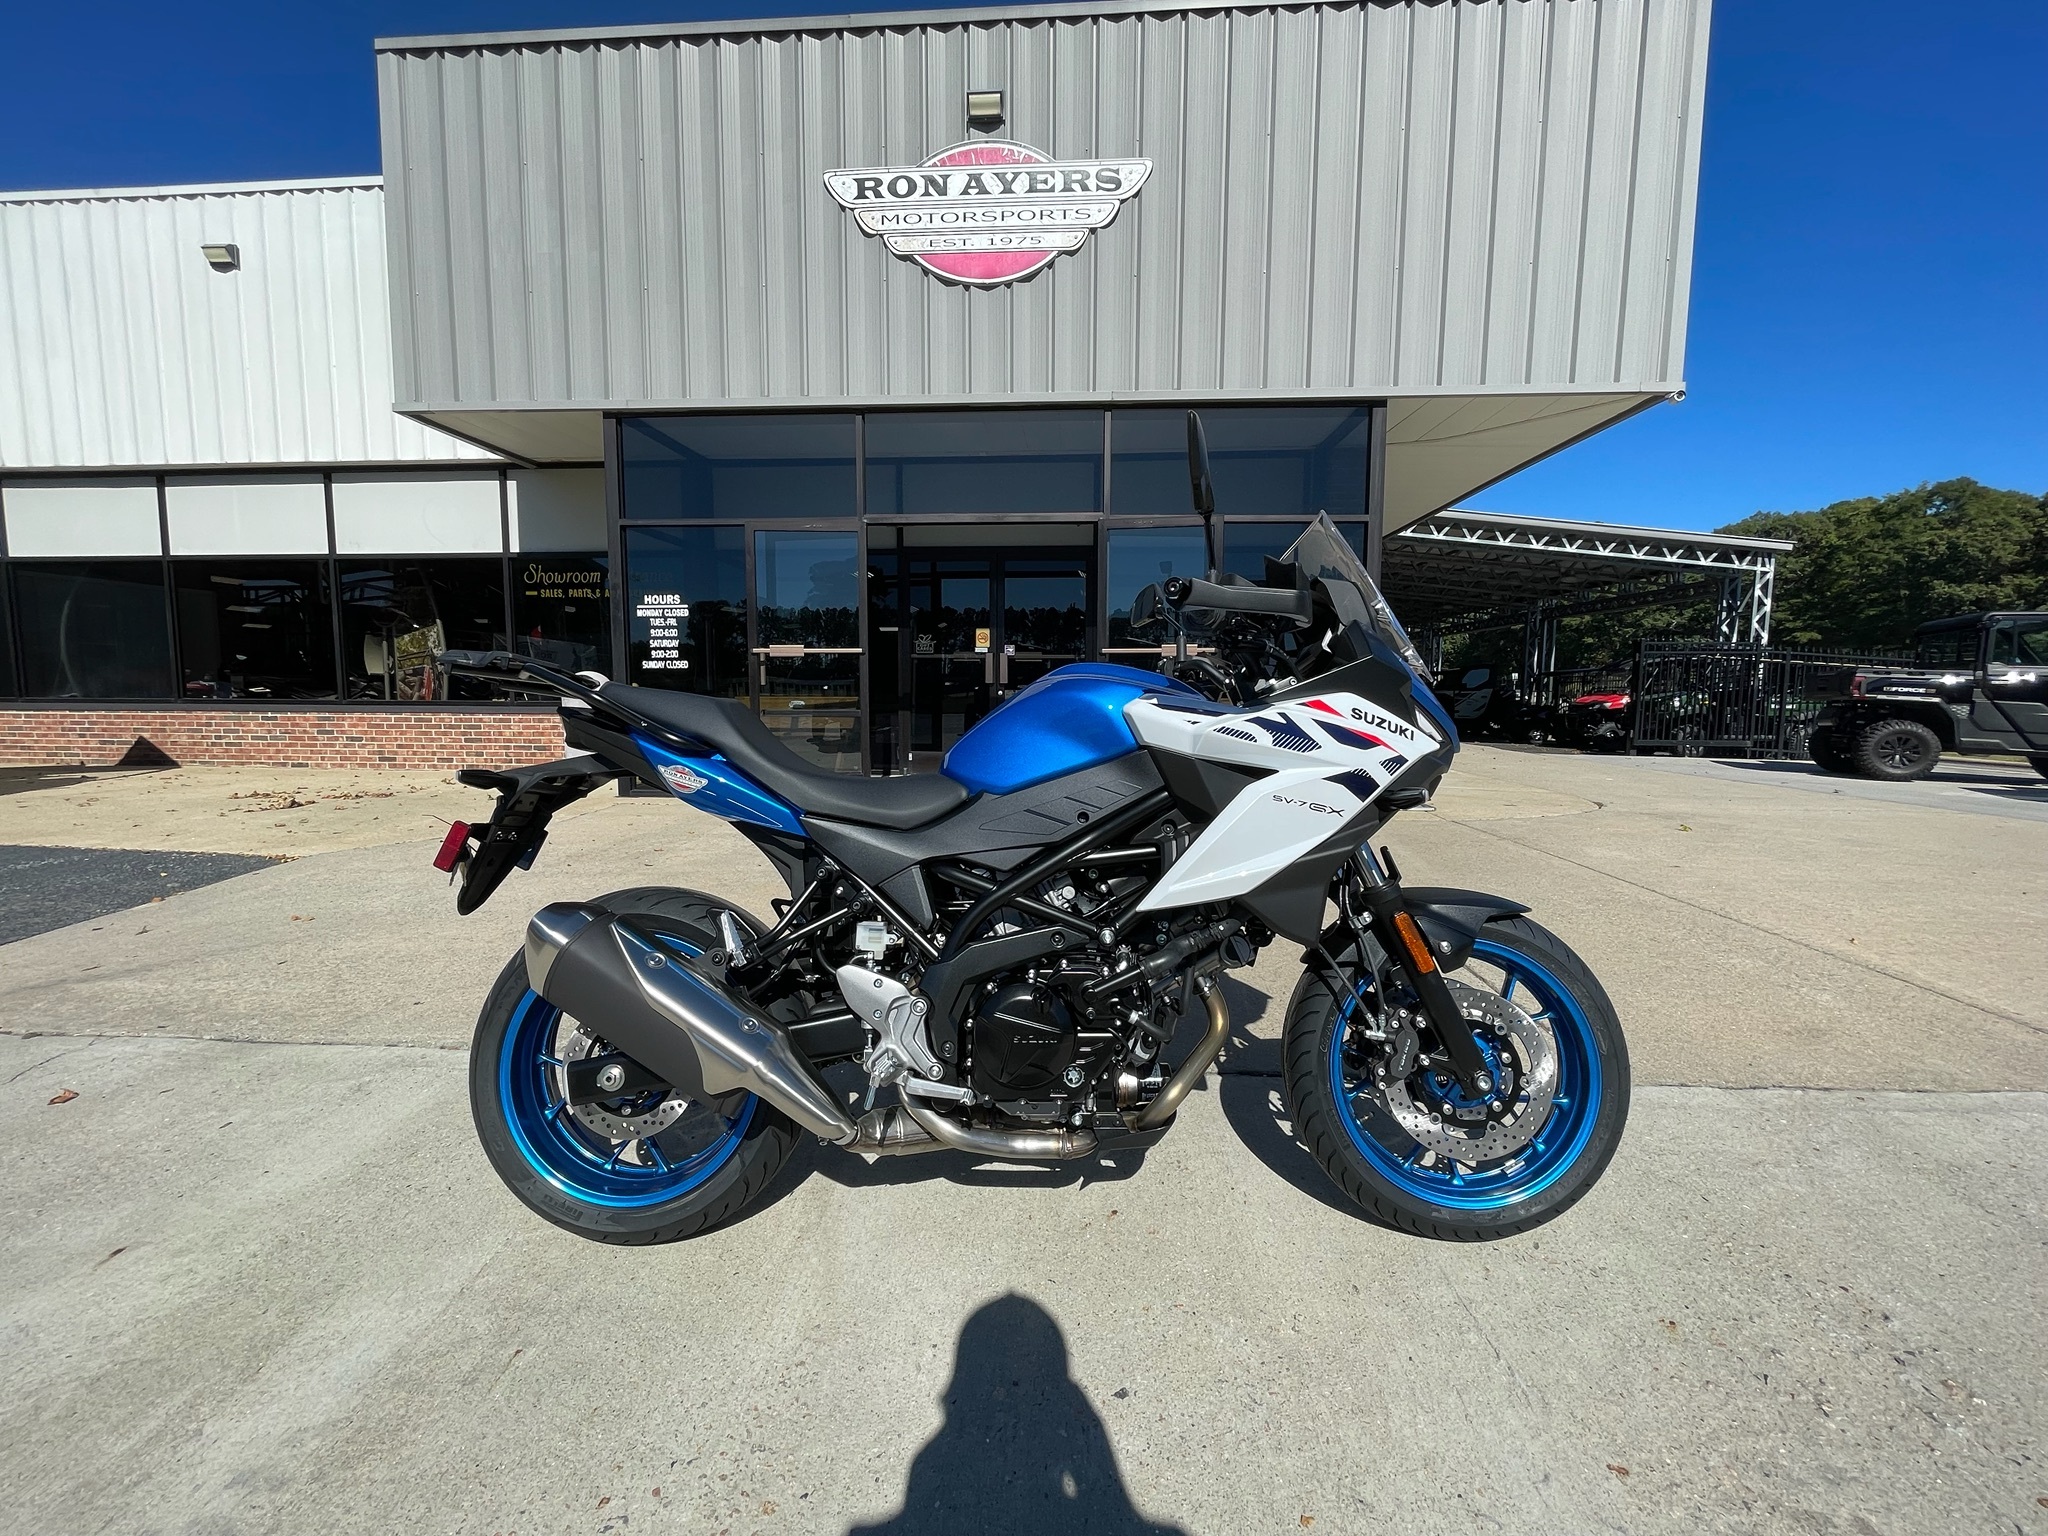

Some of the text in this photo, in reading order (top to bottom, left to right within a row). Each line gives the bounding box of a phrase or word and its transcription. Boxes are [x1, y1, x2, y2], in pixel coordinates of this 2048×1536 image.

[853, 166, 1123, 200] RON AYERS
[881, 208, 1092, 226] MOTORSPORTS
[930, 236, 1042, 248] EST. 1975
[524, 563, 601, 586] Showroom
[540, 588, 565, 599] SALES,
[568, 588, 592, 598] PARTS
[644, 594, 681, 605] HOURS
[636, 608, 689, 617] MONDAY CLOSED
[649, 639, 680, 648] SATURDAY
[642, 660, 689, 669] SUNDAY CLOSED
[1351, 707, 1415, 742] SUZUKI
